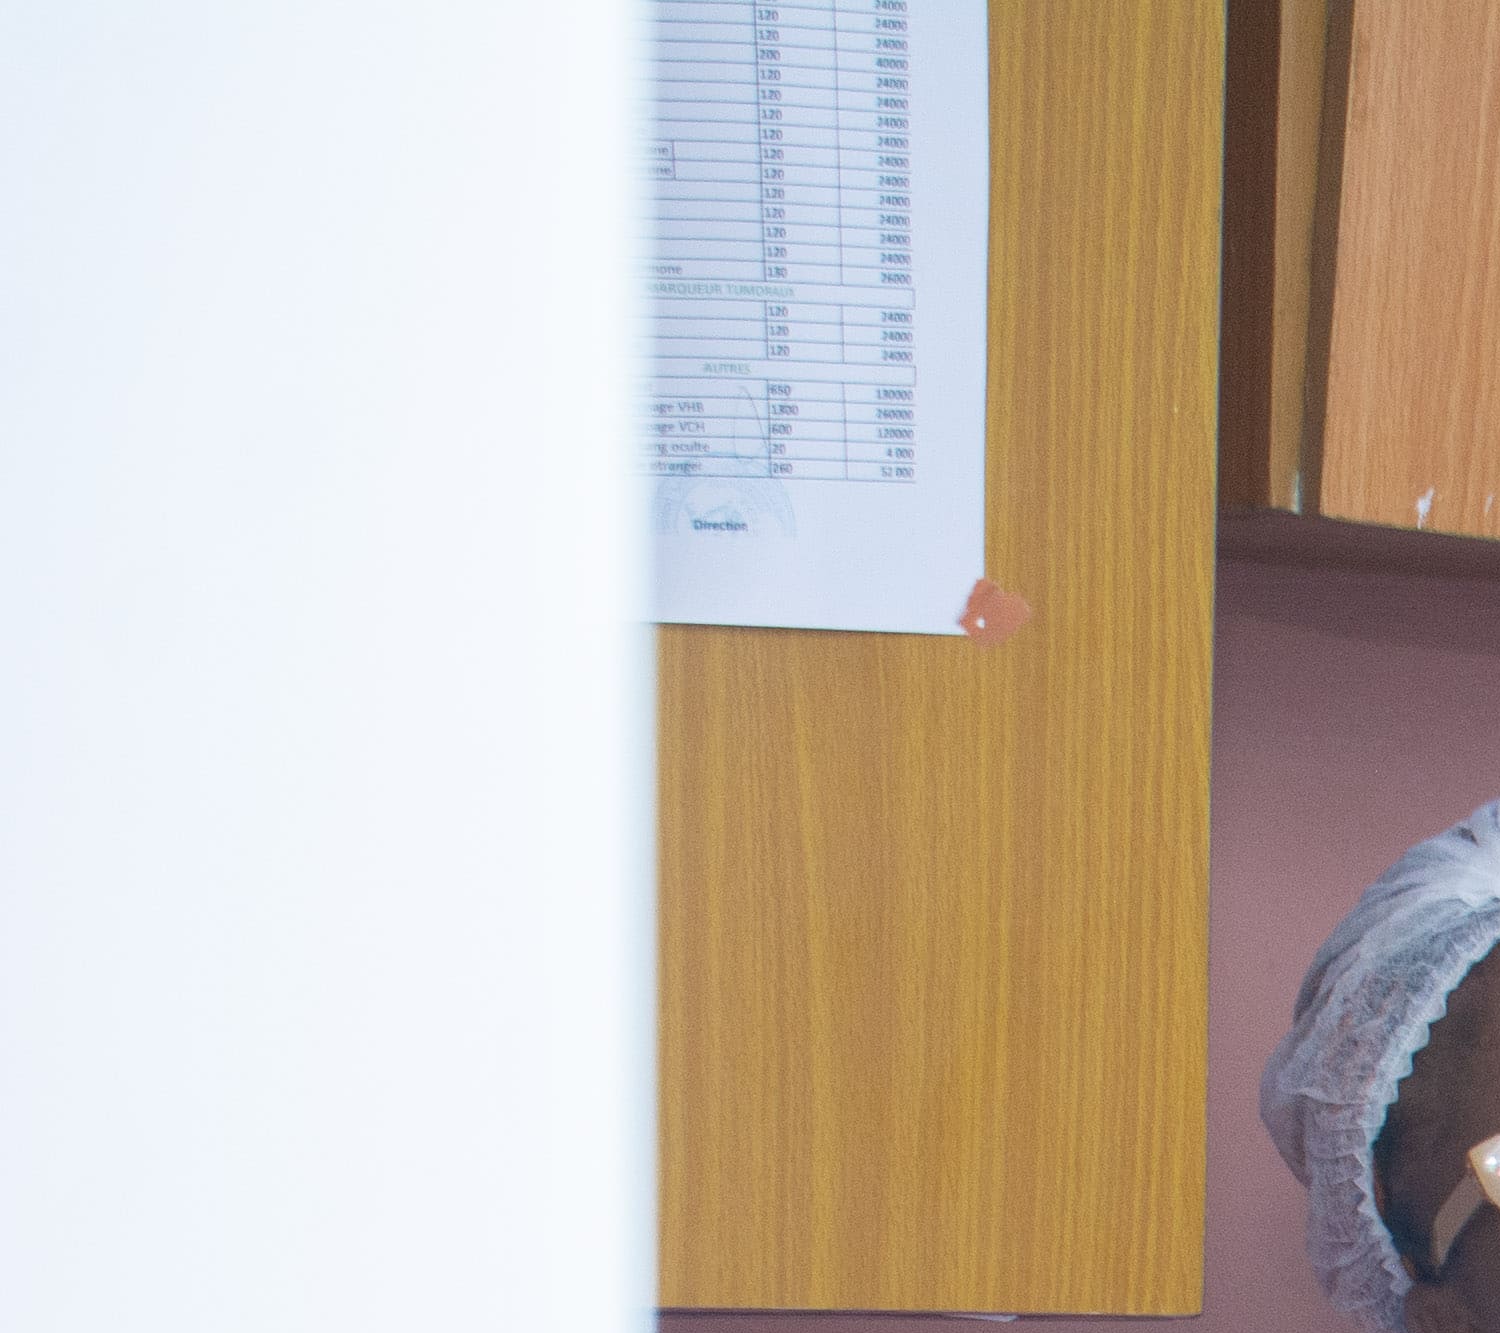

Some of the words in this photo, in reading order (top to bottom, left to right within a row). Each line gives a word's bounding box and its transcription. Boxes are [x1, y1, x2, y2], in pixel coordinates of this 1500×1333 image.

[758, 10, 779, 22] 120
[759, 30, 780, 42] 120
[759, 50, 780, 62] 200
[760, 70, 781, 82] 120
[760, 89, 781, 101] 120
[761, 109, 782, 121] 120
[762, 129, 783, 141] 120
[762, 148, 783, 160] 120
[763, 168, 784, 180] 120
[764, 188, 785, 200] 120
[764, 208, 785, 220] 120
[765, 227, 786, 239] 120
[765, 247, 786, 259] 120
[767, 306, 788, 318] 120
[768, 325, 789, 337] 120
[769, 345, 790, 357] 120
[703, 362, 752, 376] AUTRES
[771, 424, 792, 436] 600
[772, 443, 786, 455] 20
[772, 462, 793, 474] 260
[693, 519, 749, 533] Direction
